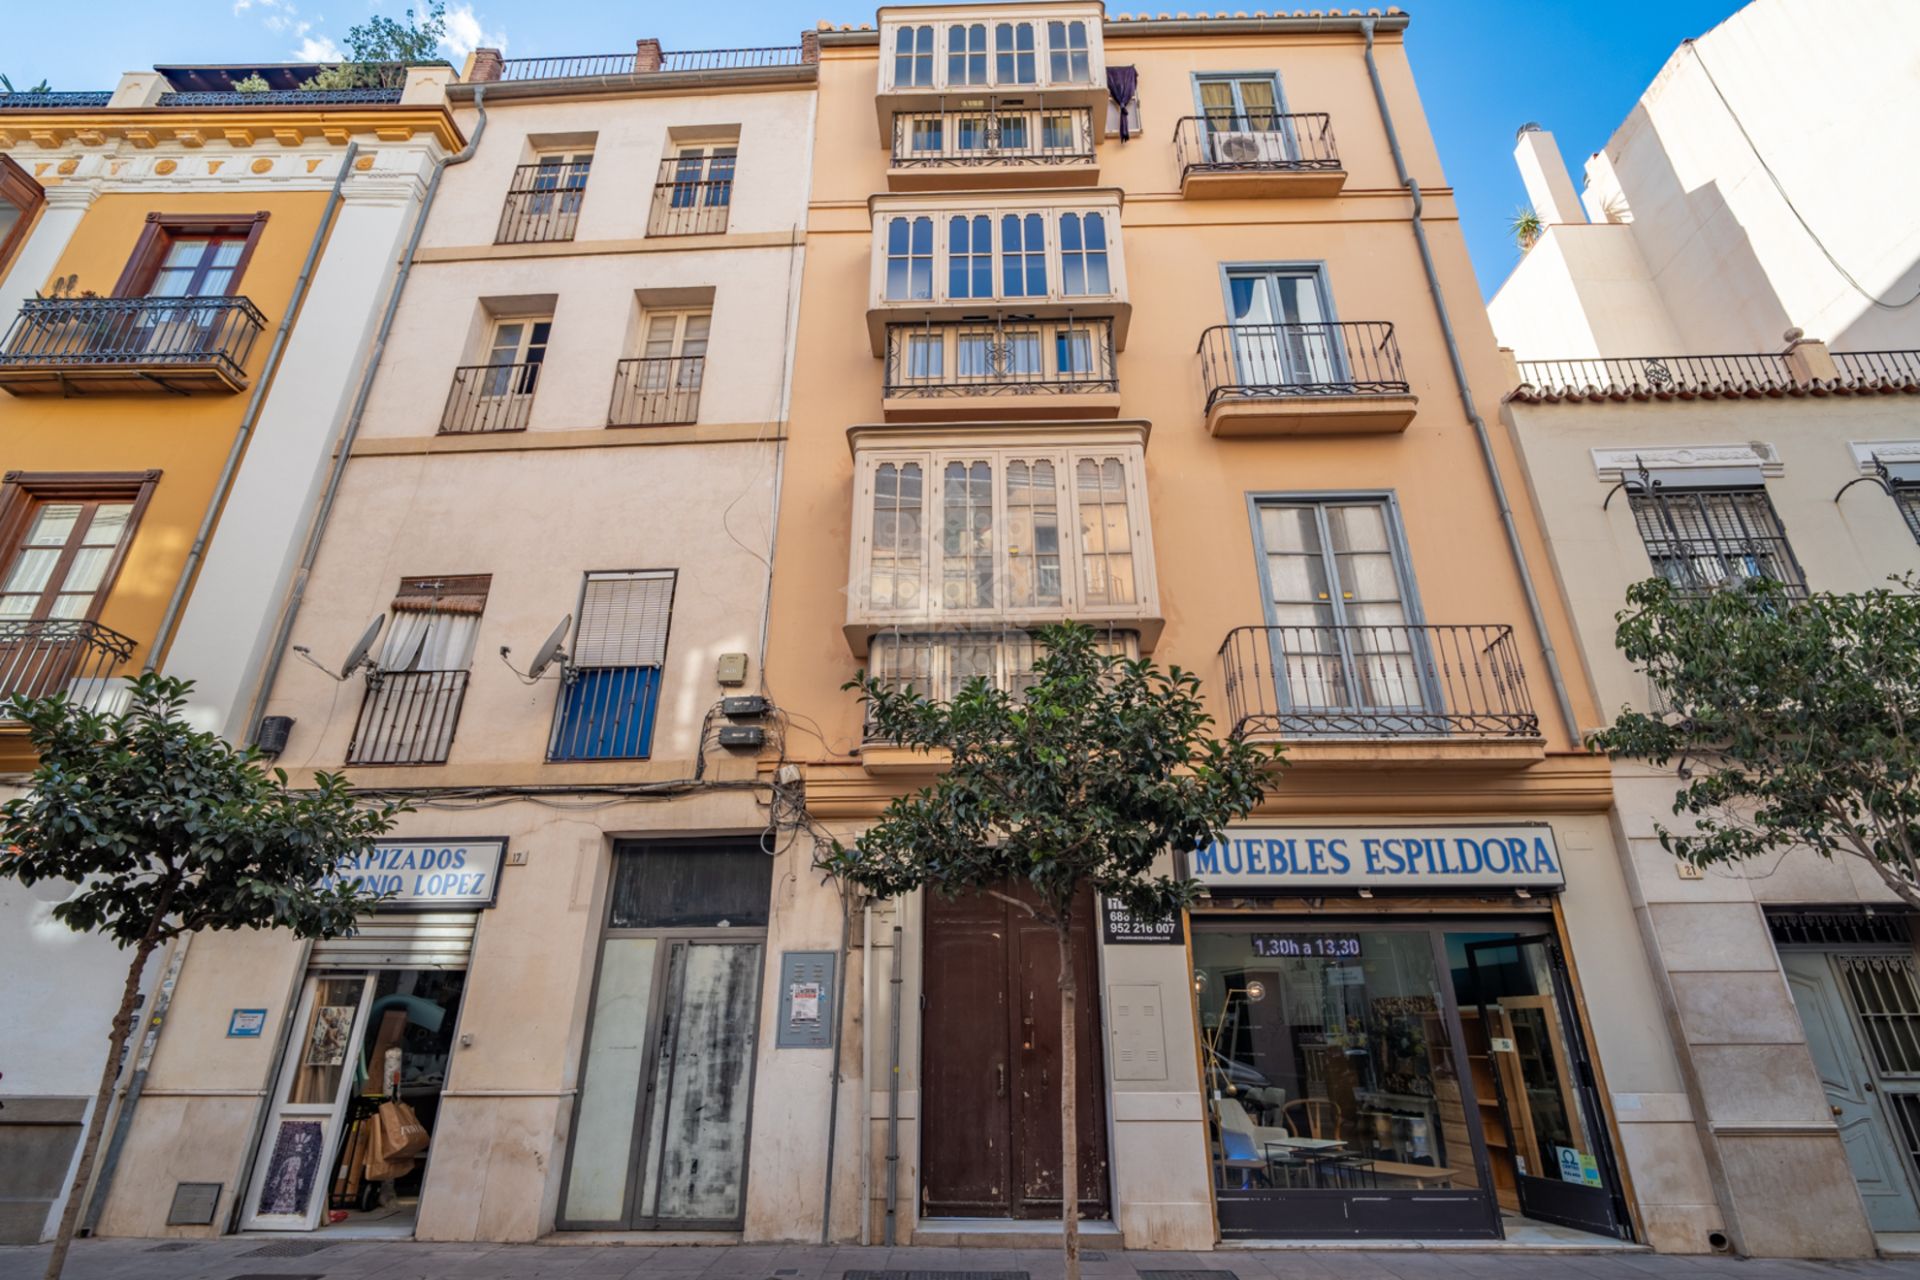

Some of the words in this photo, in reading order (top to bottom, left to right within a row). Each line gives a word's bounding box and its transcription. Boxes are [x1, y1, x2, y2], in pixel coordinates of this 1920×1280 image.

[512, 852, 522, 863] 17
[1195, 838, 1351, 875] MUEBLES
[1360, 837, 1558, 875] ESPILDORA
[319, 874, 403, 897] NONIO
[413, 873, 486, 896] LOPEZ
[1110, 923, 1131, 933] 952
[1132, 923, 1153, 933] 216
[1156, 923, 1176, 933] 007
[1303, 943, 1312, 955] a
